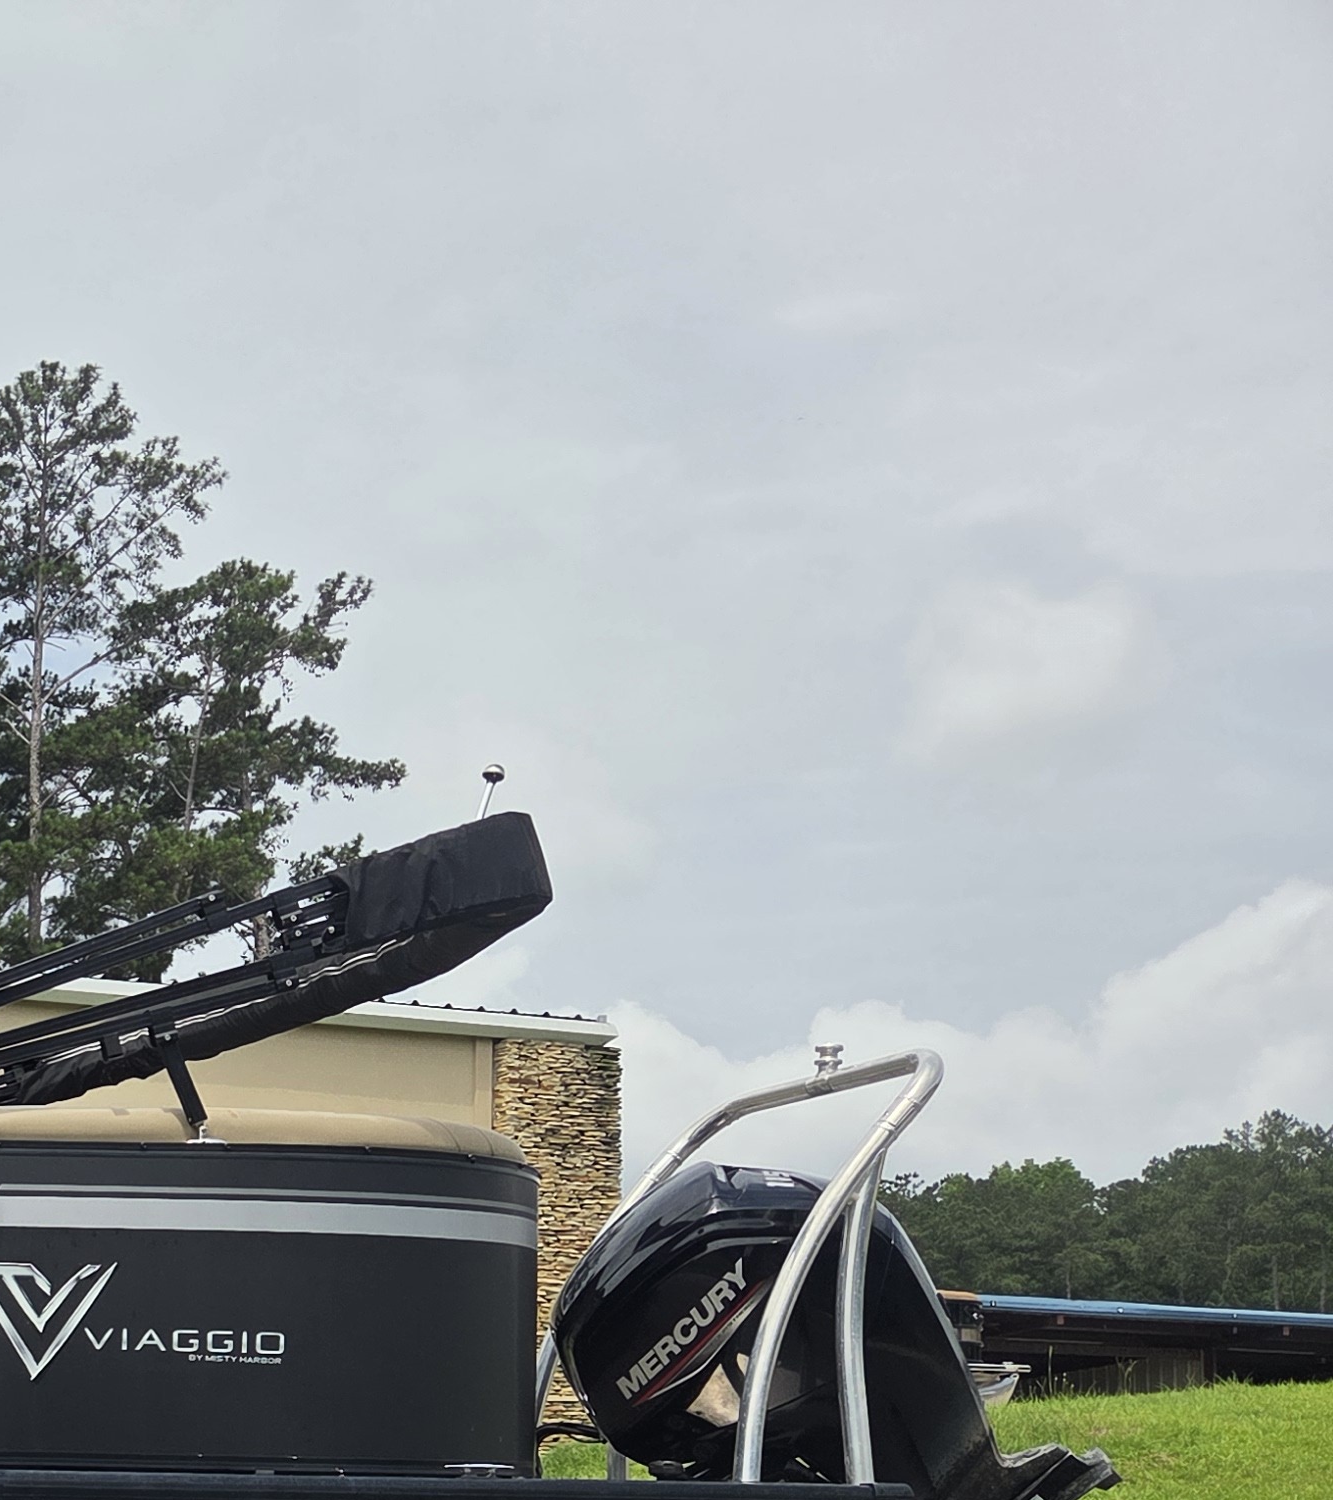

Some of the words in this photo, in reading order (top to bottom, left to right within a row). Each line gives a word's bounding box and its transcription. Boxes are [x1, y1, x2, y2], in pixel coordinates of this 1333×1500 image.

[83, 1327, 285, 1355] VIAGGIO
[615, 1256, 747, 1400] MERCURY
[188, 1353, 204, 1362] BY
